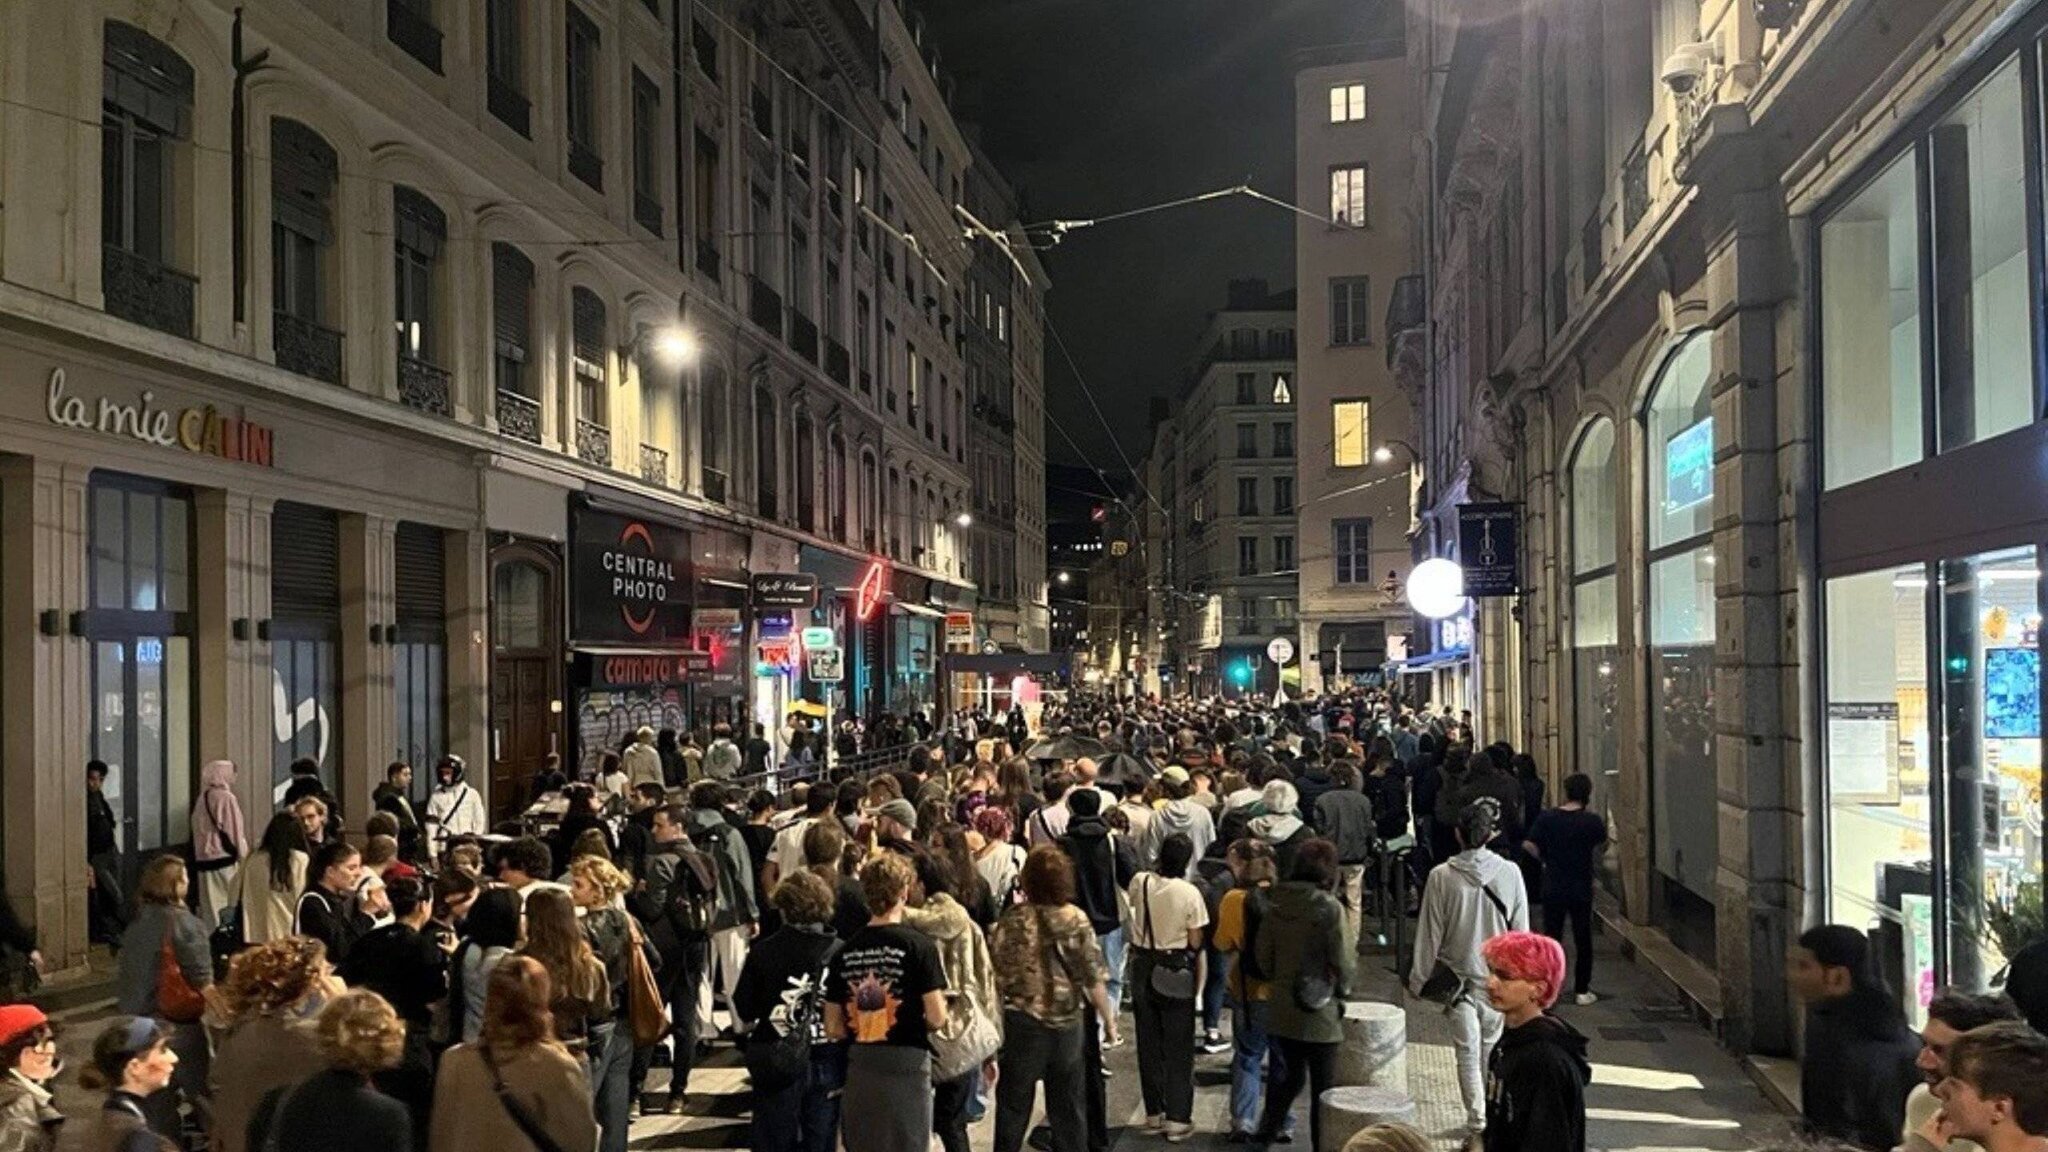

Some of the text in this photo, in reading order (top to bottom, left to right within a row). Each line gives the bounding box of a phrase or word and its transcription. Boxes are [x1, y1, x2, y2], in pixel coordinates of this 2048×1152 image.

[48, 366, 92, 428] la
[100, 391, 176, 446] mie
[602, 551, 675, 581] CENTRAL
[613, 577, 666, 601] PHOTO
[605, 657, 671, 684] camara
